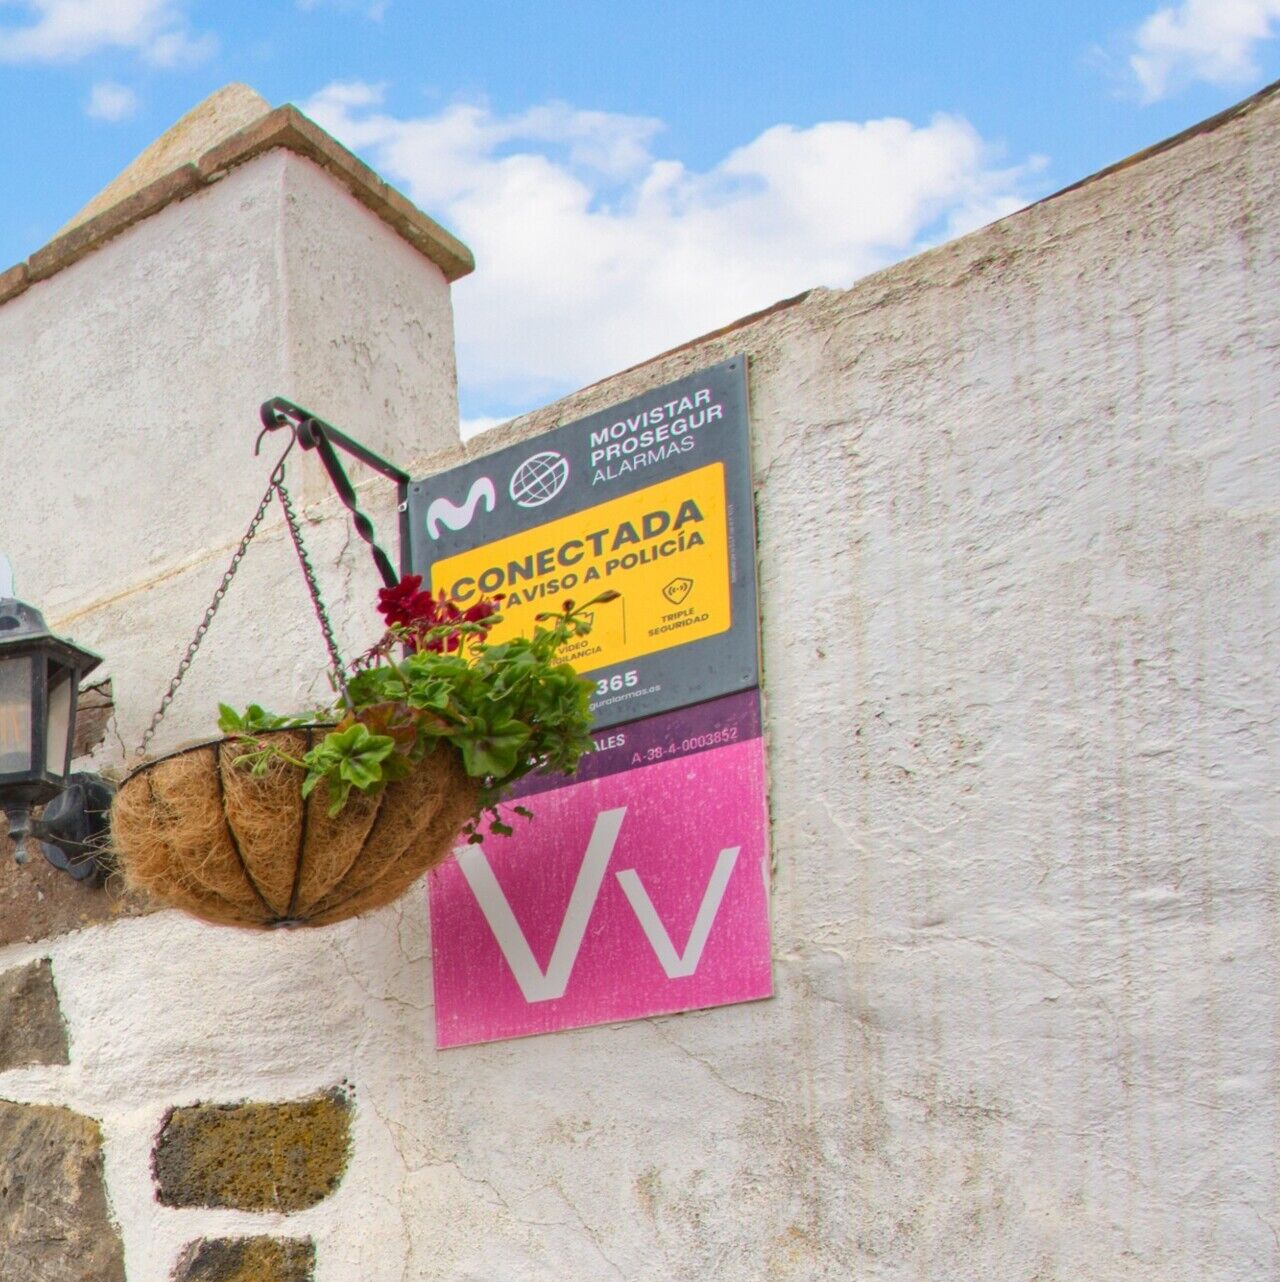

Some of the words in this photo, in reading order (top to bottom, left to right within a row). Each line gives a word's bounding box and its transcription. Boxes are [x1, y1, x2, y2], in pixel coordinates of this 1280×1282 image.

[590, 388, 711, 448] MOVISTAR
[591, 404, 724, 467] PROSEGUR
[592, 435, 696, 486] ALARMAS
[450, 499, 705, 603] CONECTADA
[506, 573, 578, 609] AVISO
[584, 566, 600, 584] A
[605, 531, 706, 576] POLICÍA
[648, 613, 709, 637] SEGURIDAD
[661, 607, 695, 623] TRIPLE
[550, 646, 603, 666] IGILANCIA
[558, 640, 589, 655] VIDEO
